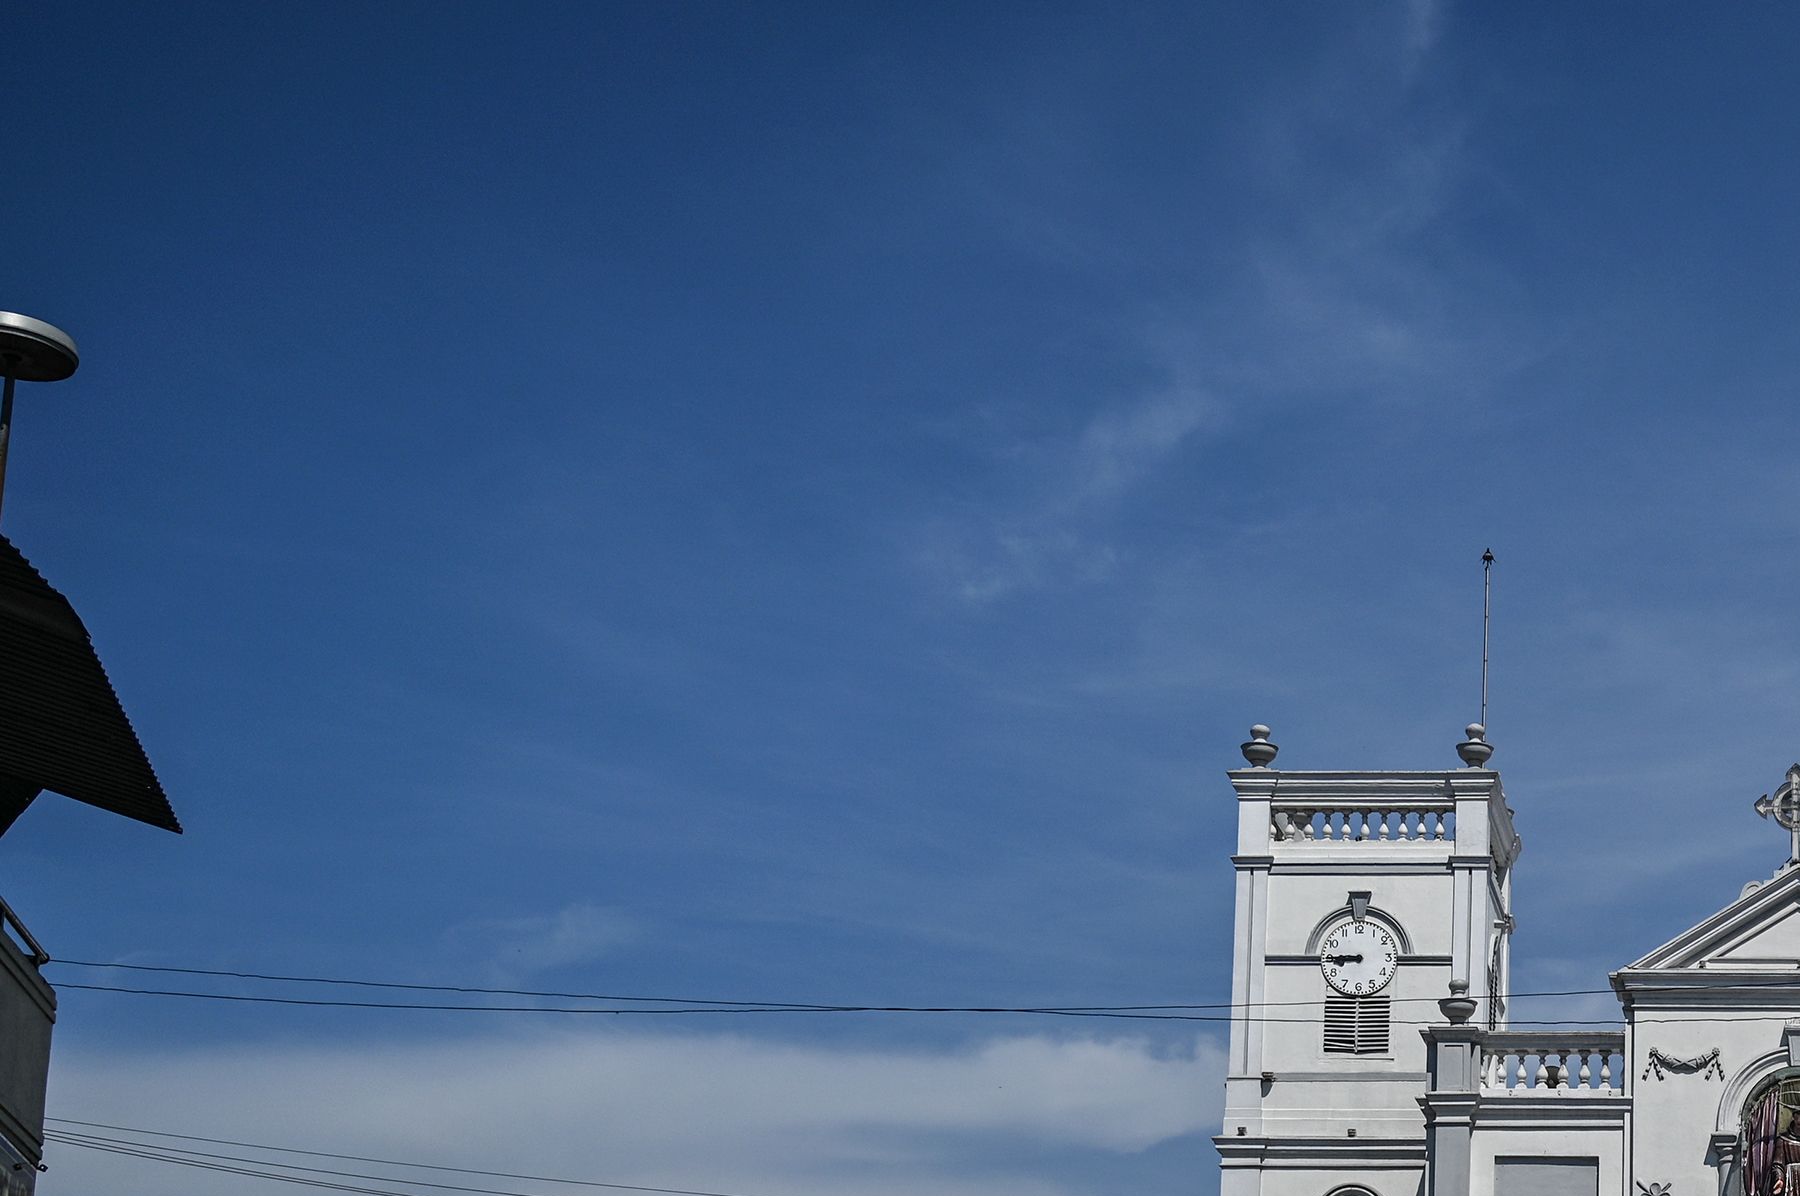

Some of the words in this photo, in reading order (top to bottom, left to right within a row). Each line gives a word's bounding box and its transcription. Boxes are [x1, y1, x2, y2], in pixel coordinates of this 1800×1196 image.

[1341, 929, 1348, 938] 11
[1355, 925, 1364, 934] 12
[1372, 929, 1375, 938] 1
[1329, 939, 1338, 948] 10
[1381, 936, 1388, 945] 2
[1385, 953, 1392, 963] 3
[1330, 968, 1337, 978] 8
[1379, 967, 1386, 976] 4
[1341, 979, 1348, 989] 7
[1355, 982, 1362, 991] 6
[1368, 979, 1376, 989] 5
